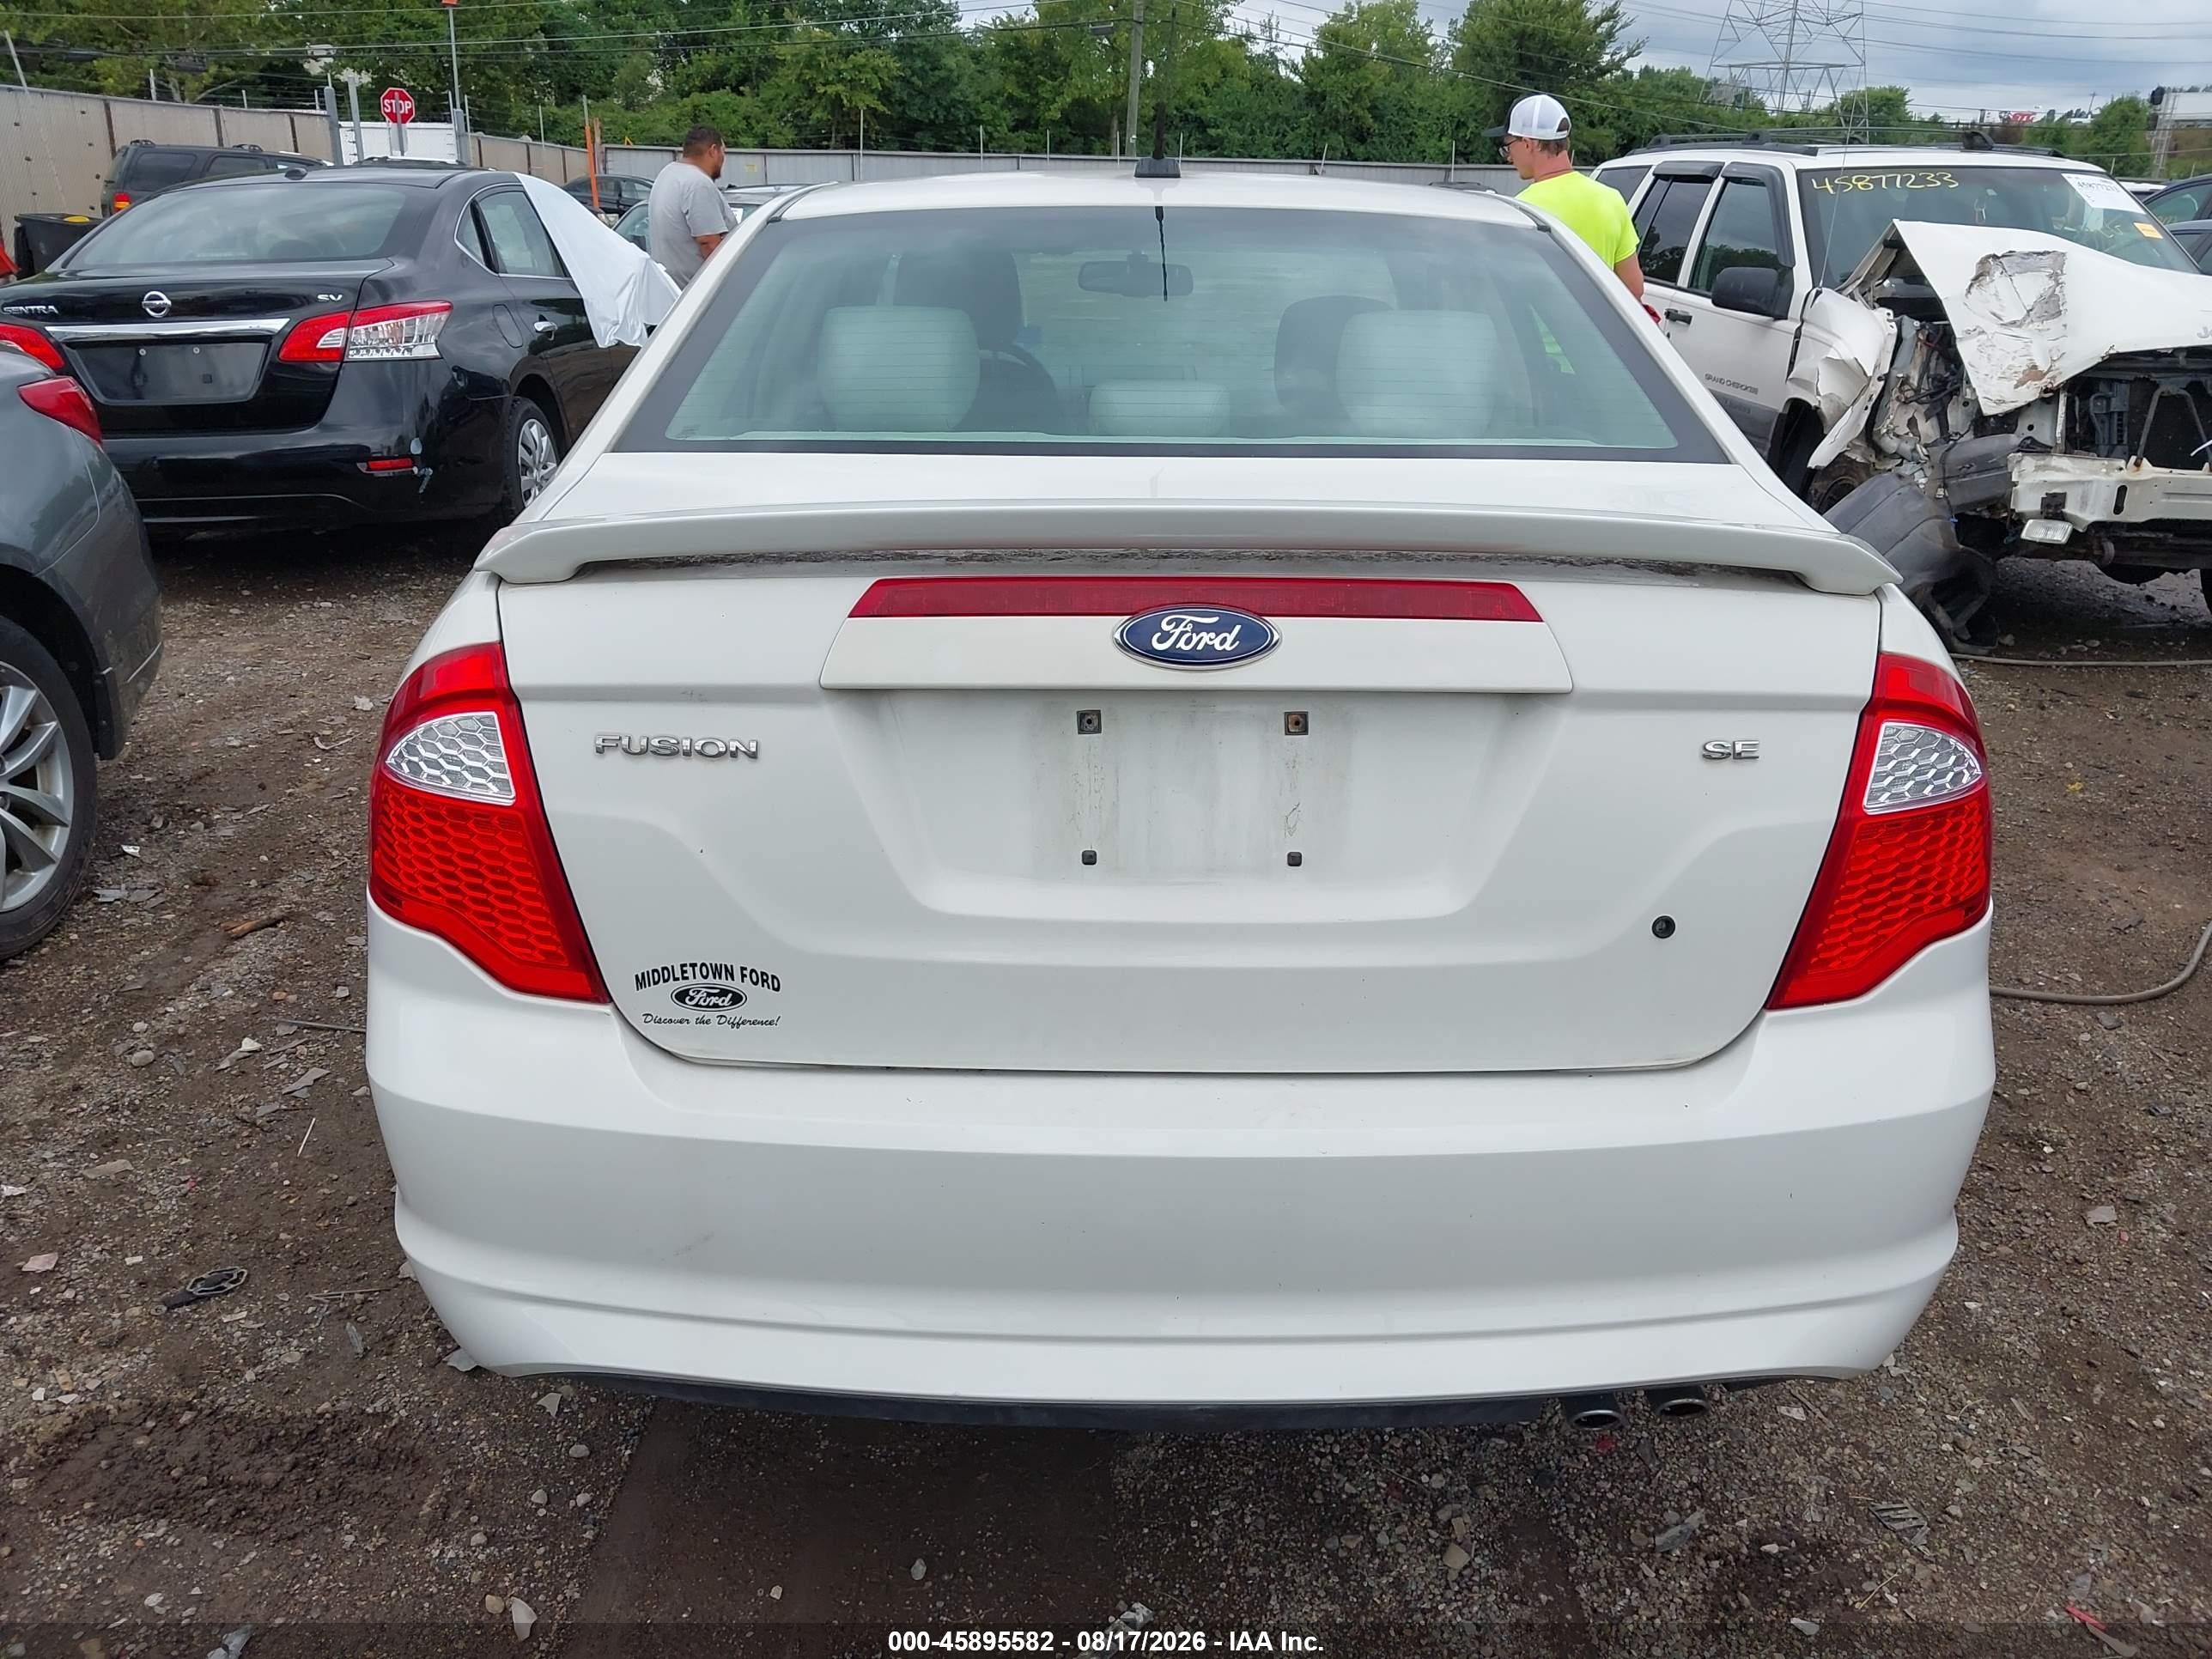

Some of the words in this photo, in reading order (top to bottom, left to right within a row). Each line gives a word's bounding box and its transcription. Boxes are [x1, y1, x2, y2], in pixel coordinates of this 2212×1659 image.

[384, 99, 412, 114] STOP
[1812, 172, 1959, 195] 45877233
[3, 305, 59, 315] SENTRA
[1152, 614, 1242, 652] Ford
[594, 734, 758, 760] FUSION
[1702, 739, 1759, 760] SE
[635, 962, 735, 991] MIDDLETOWN
[739, 966, 781, 993] FORD
[684, 988, 733, 1006] Ford
[642, 1013, 690, 1025] Discover
[695, 1014, 712, 1025] the
[715, 1014, 781, 1030] Difference!
